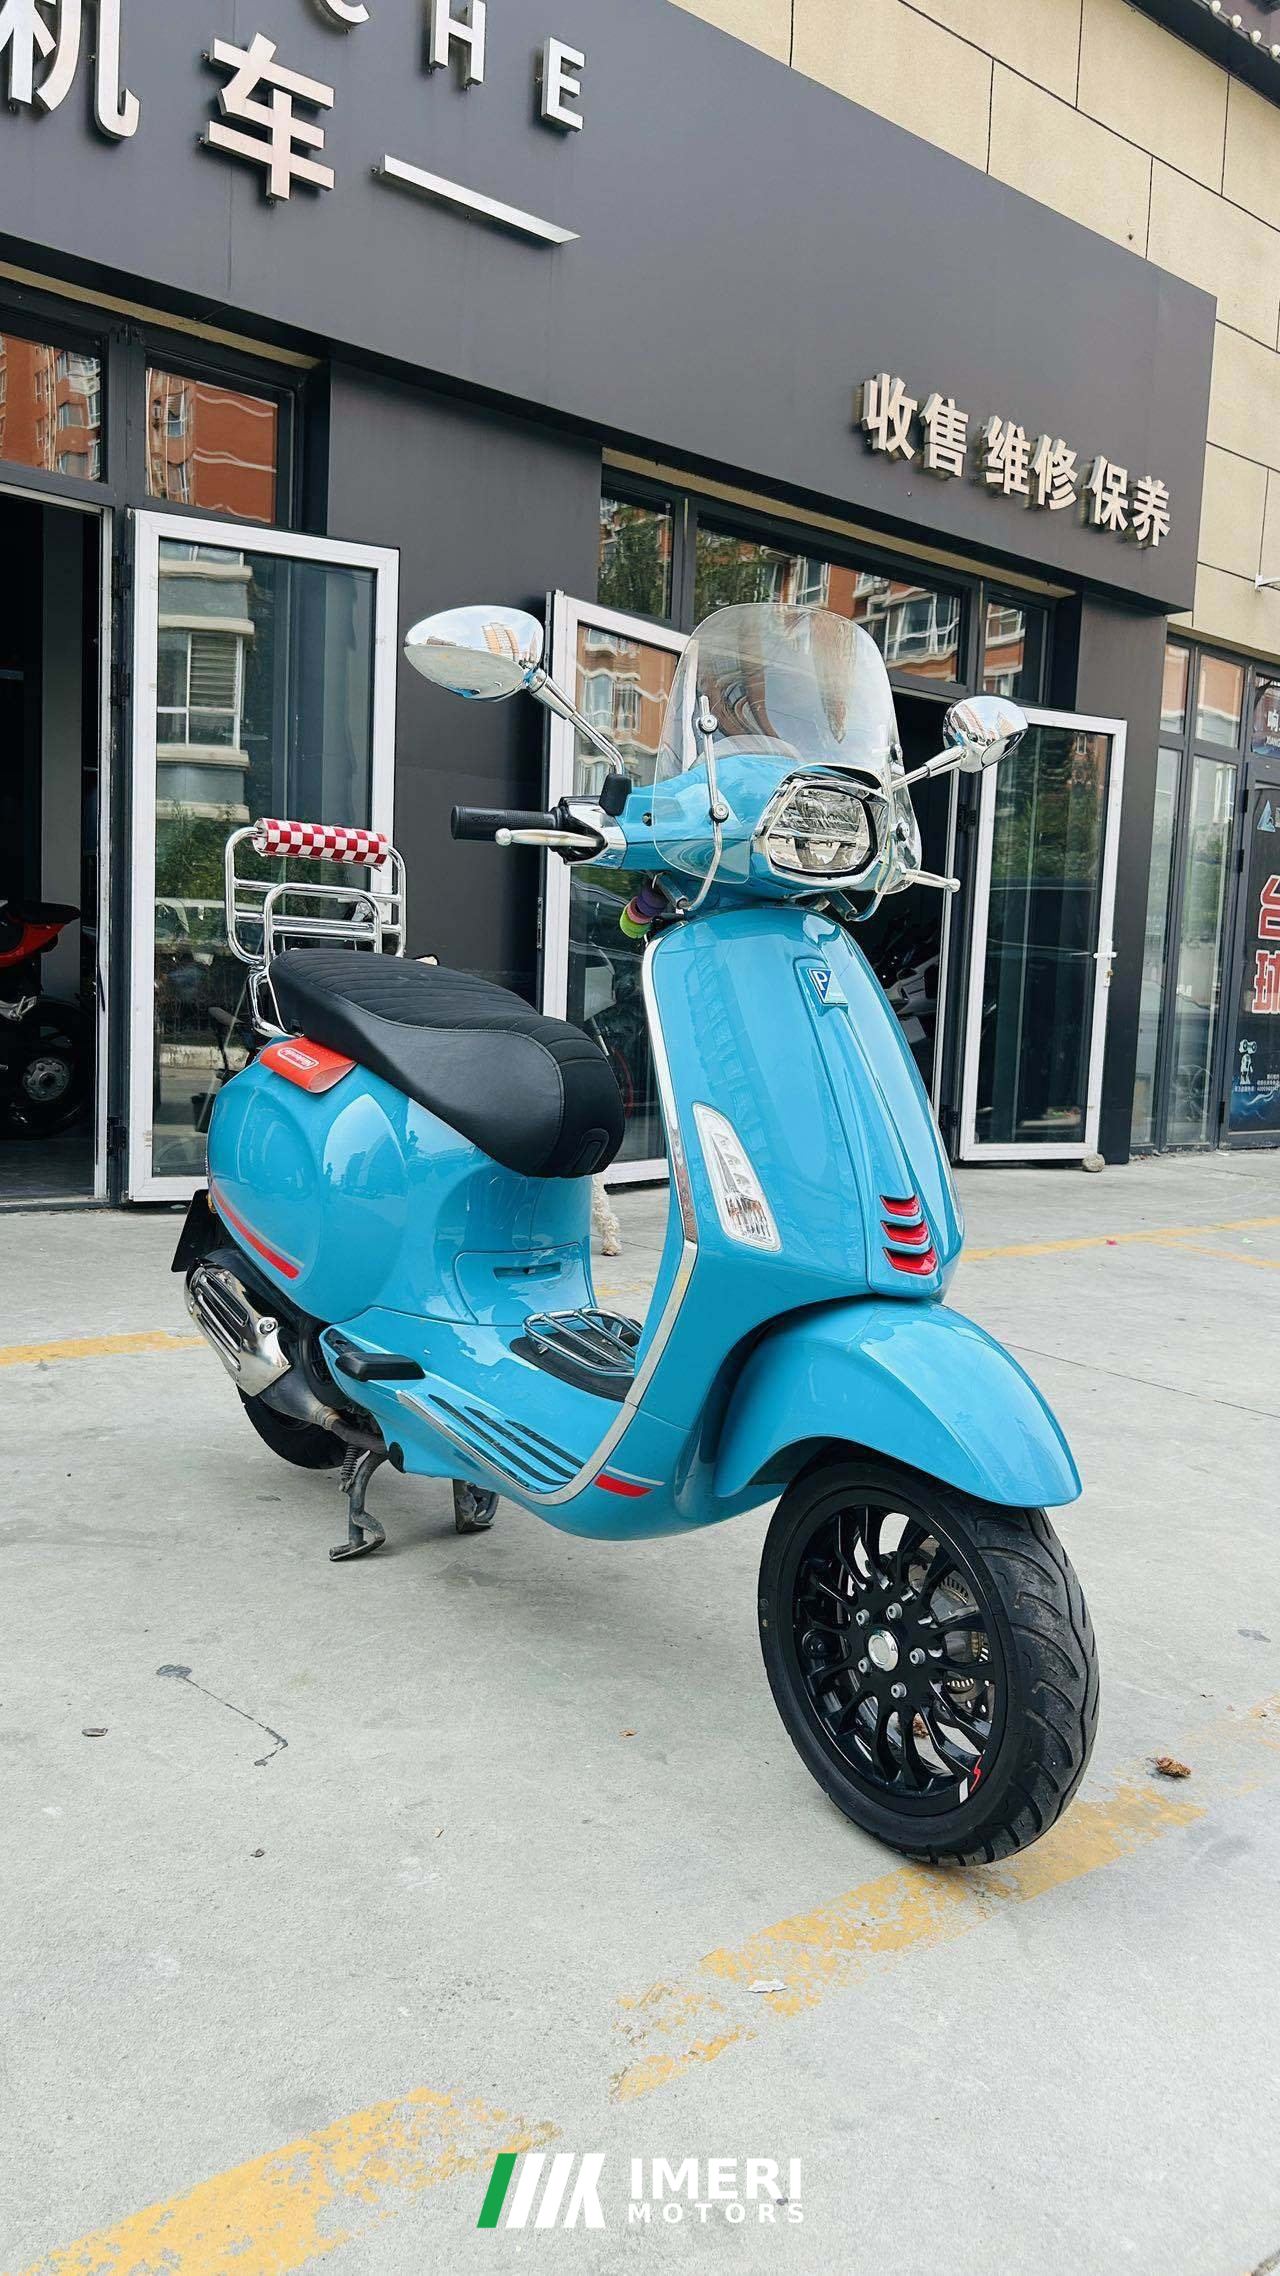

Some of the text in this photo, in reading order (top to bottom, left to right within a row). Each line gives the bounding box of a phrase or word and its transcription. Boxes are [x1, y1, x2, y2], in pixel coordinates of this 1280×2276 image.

[312, 0, 585, 132] HE
[861, 373, 1171, 547] 收售 维修 保养
